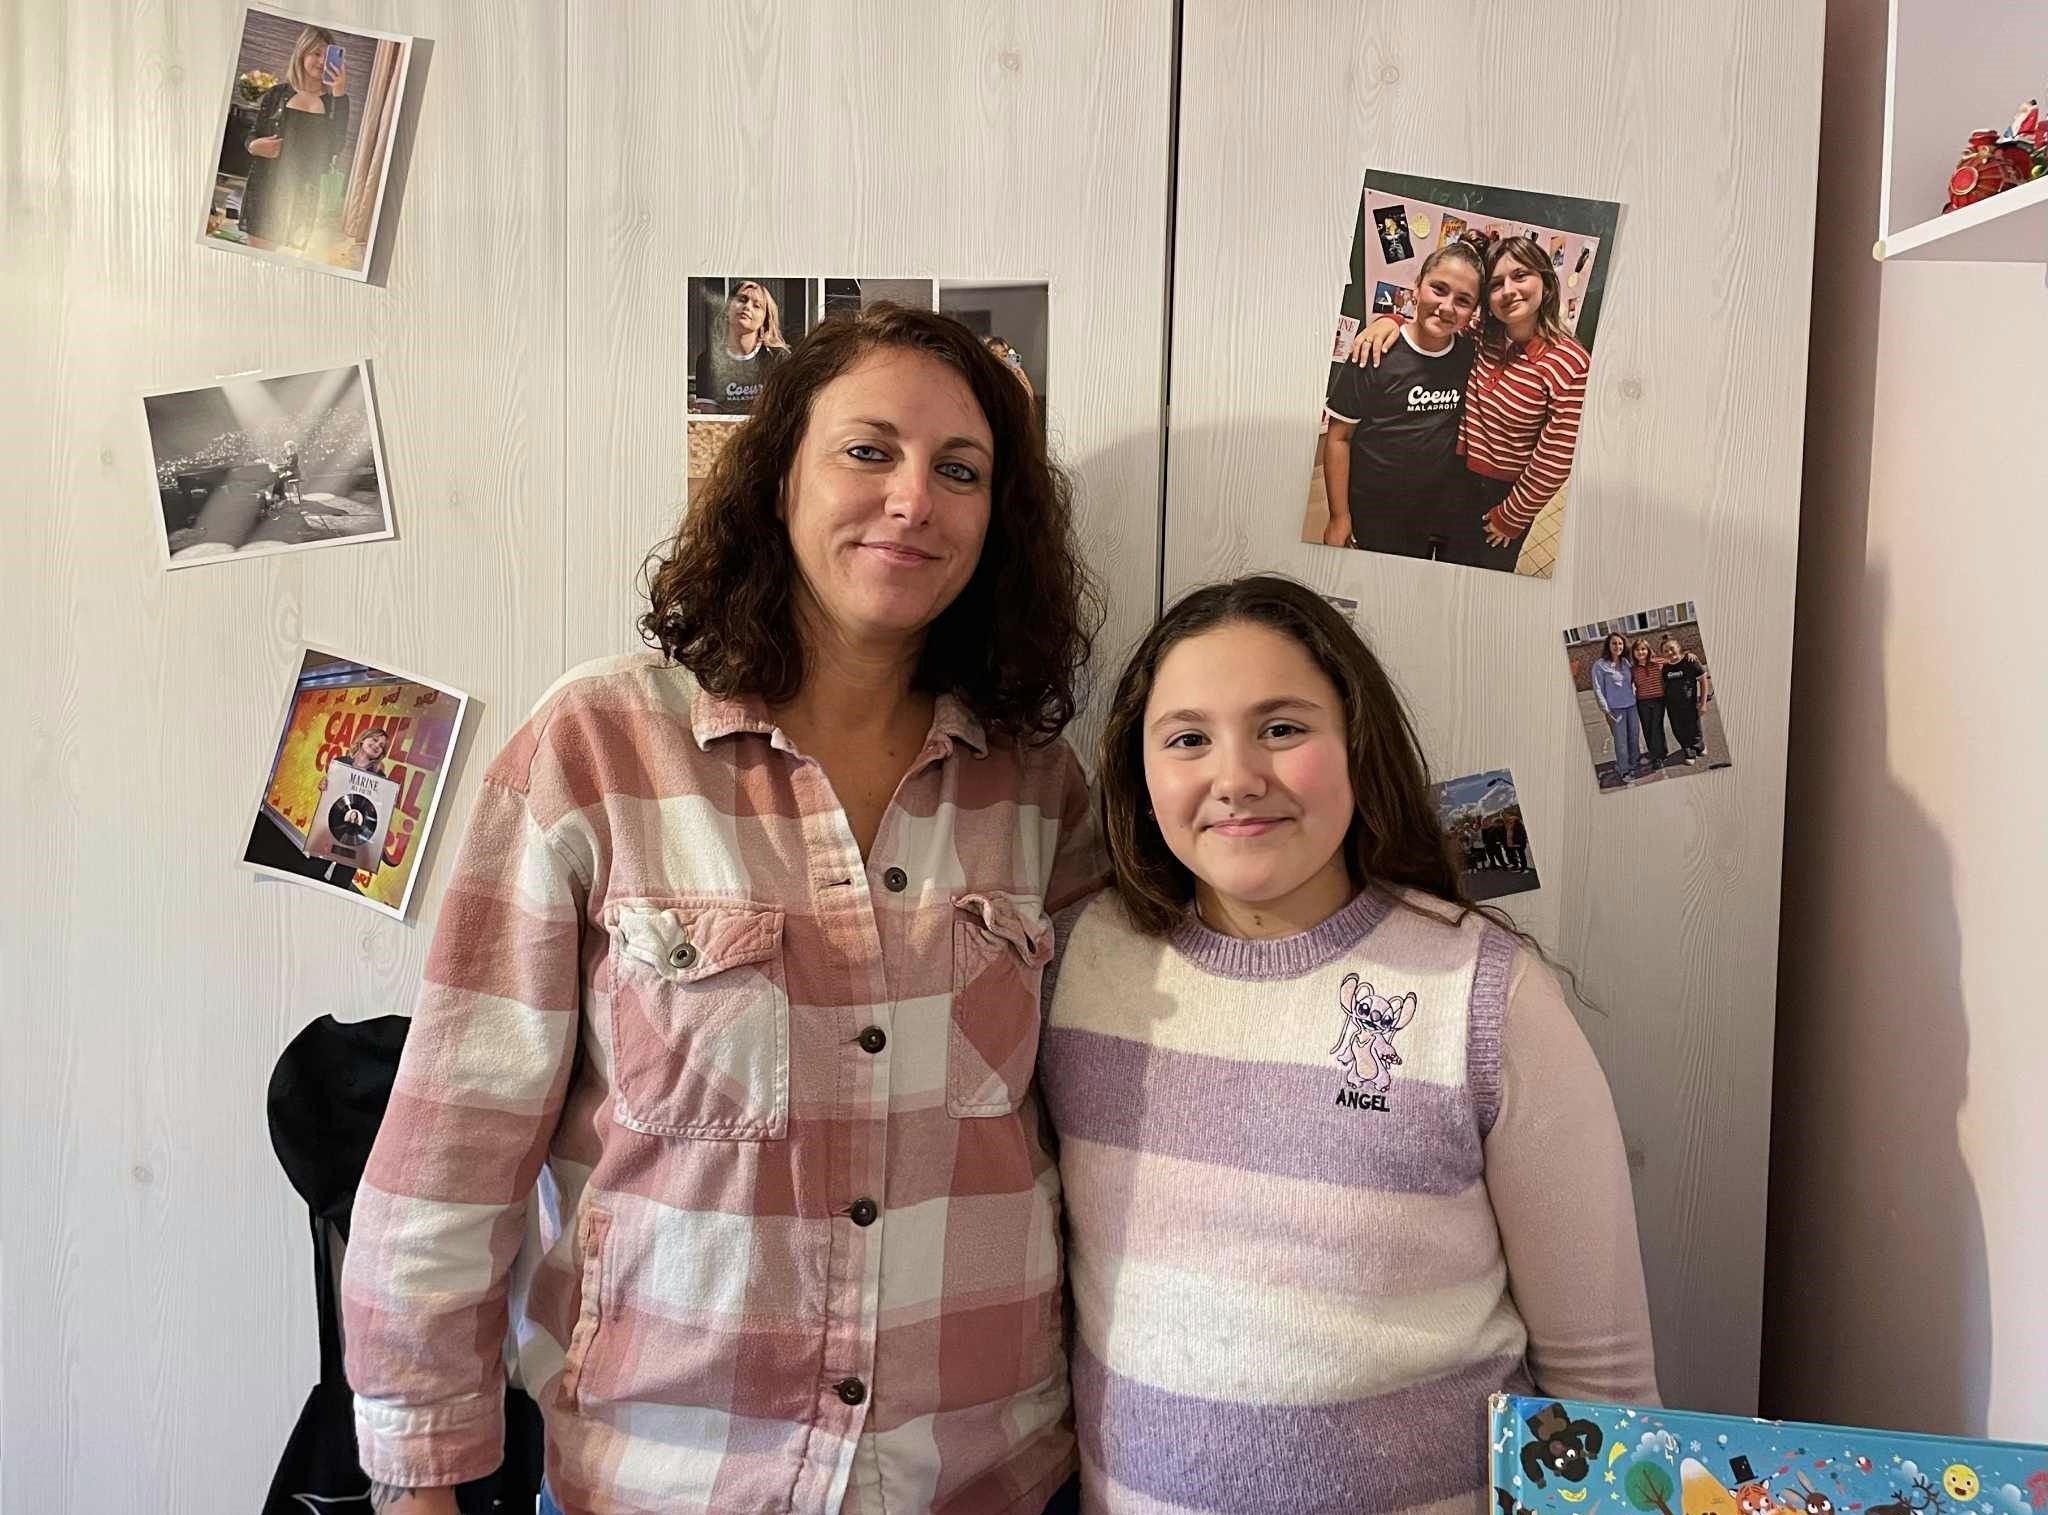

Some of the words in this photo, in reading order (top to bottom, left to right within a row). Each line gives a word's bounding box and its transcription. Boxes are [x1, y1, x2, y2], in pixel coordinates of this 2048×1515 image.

[1408, 385, 1461, 405] Coeur
[1407, 403, 1458, 412] MALADROIT
[350, 772, 379, 790] MARINE
[1336, 1088, 1390, 1113] ANGEL
